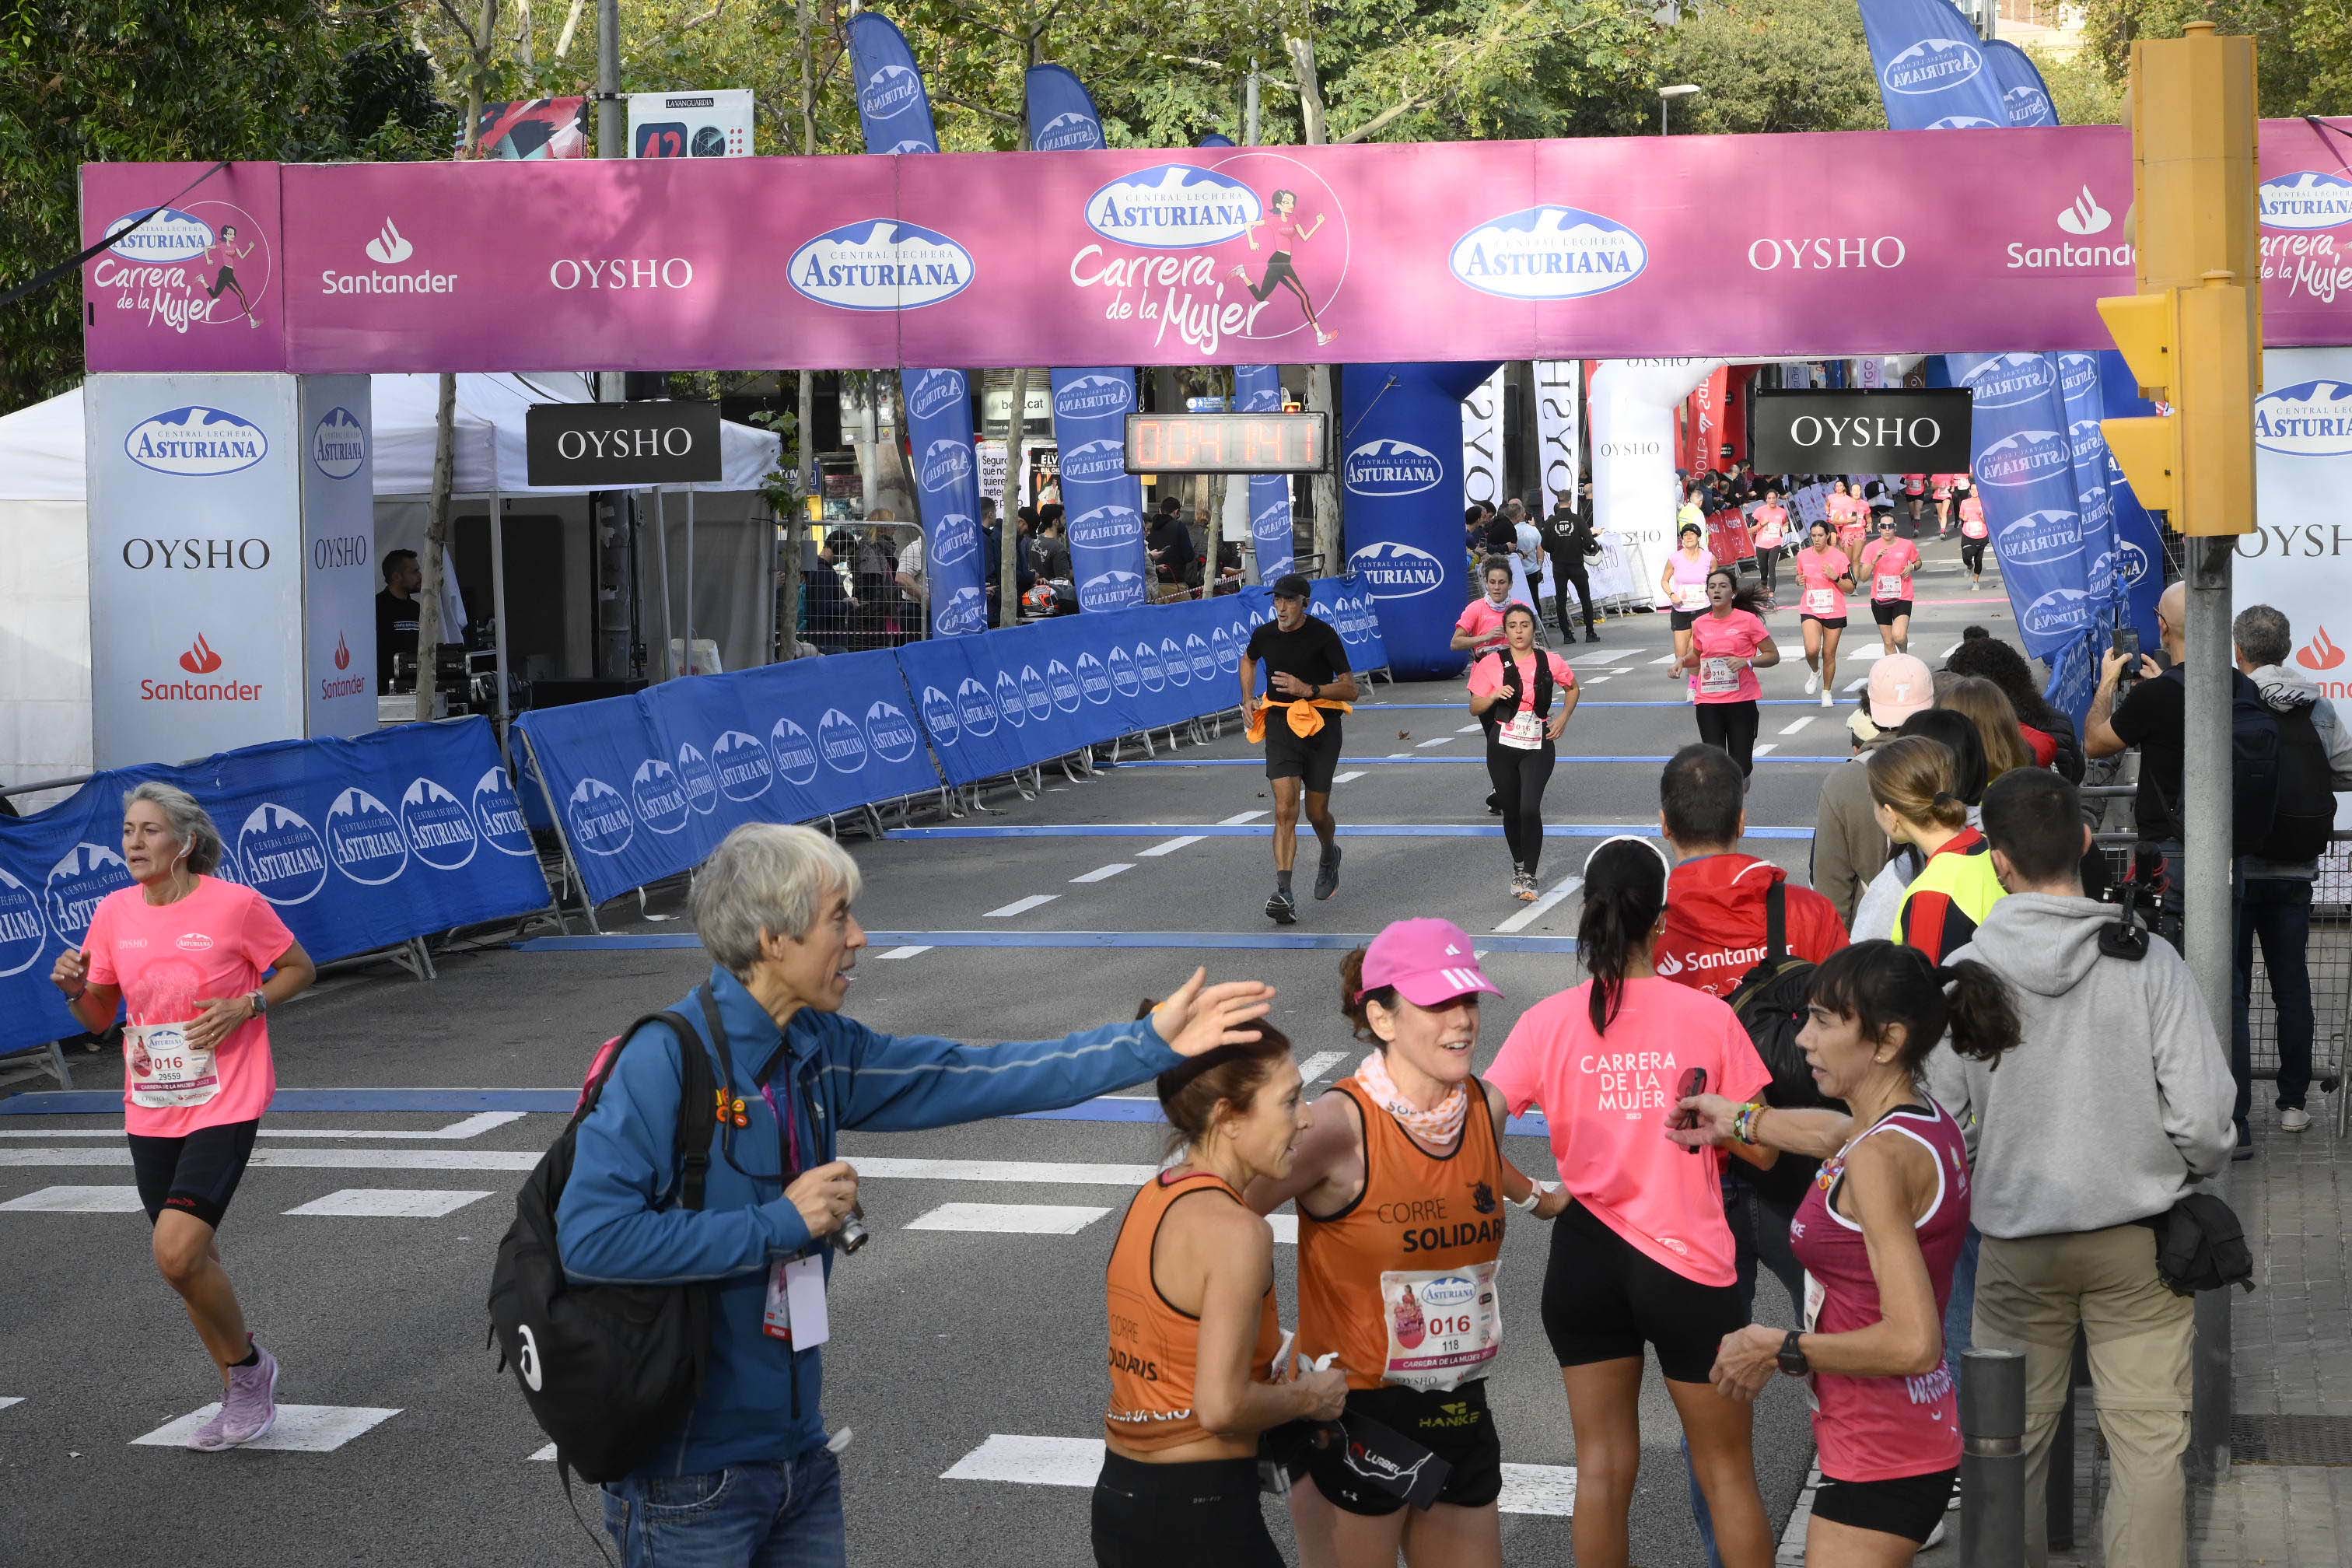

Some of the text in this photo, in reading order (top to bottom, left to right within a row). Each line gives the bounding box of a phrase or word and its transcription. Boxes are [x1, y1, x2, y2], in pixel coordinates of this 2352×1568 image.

[1125, 192, 1244, 202] CENTRAL LECHERA
[1098, 196, 1248, 228] ASTURIANA
[114, 227, 205, 249] ASTURIANA
[1563, 236, 1626, 247] LECHERA
[2259, 234, 2334, 257] arrera
[831, 250, 954, 261] CENTRAL LECHERA
[1465, 241, 1633, 277] ASTURIANA
[1748, 236, 1906, 271] OYSHO
[94, 259, 186, 288] Carrera
[550, 258, 693, 289] OYSHO
[801, 254, 961, 287] ASTURIANA
[1069, 244, 1216, 288] Carrera
[2278, 257, 2293, 279] la
[2288, 252, 2352, 303] Muje
[322, 269, 458, 293] Santander
[117, 285, 221, 334] de la Mujer
[1105, 282, 1270, 355] de la Mujer
[2277, 407, 2329, 415] CENTRAL
[558, 427, 692, 460] OYSHO
[1790, 416, 1941, 447] OYSHO
[136, 432, 257, 459] ASTURIANA
[317, 435, 362, 461] ASTURIANA
[1601, 442, 1660, 457] OYSHO
[1041, 455, 1059, 464] ELV
[983, 478, 1008, 486] quiere
[1348, 462, 1435, 484] ASTURIANA
[314, 535, 366, 569] OYSHO
[2234, 523, 2352, 558] OYSH
[123, 538, 271, 569] OYSHO
[141, 679, 263, 701] Santander
[321, 674, 365, 700] Santander
[775, 744, 816, 771] ASTURIANA
[822, 734, 865, 760] ASTURIANA
[414, 806, 460, 821] CENTRAL LECHERA
[487, 797, 511, 809] CENTRAL
[341, 817, 392, 833] CENTRAL LECHERA
[481, 803, 526, 838] ASTUR
[254, 831, 312, 851] CENTRAL LECHERA
[408, 815, 474, 851] ASTURIANA
[333, 827, 405, 865] ASTURIANA
[246, 845, 324, 885] ASTURIANA
[63, 882, 96, 896] CENTRAL
[149, 1036, 183, 1047] ASTURIANA
[154, 1056, 183, 1069] 016
[1580, 1052, 1677, 1074] CARRERA
[159, 1073, 181, 1081] 29559
[1601, 1071, 1661, 1091] DE LA
[184, 1090, 214, 1101] Santander
[1598, 1090, 1666, 1111] MUJER
[1377, 1198, 1448, 1224] CORRE
[1402, 1221, 1504, 1253] SOLIDAR
[1426, 1288, 1474, 1300] ASTURIANA
[1111, 1314, 1139, 1344] CORRE
[1430, 1315, 1471, 1335] 016
[1442, 1340, 1459, 1352] 118
[1402, 1359, 1437, 1368] CARRERA
